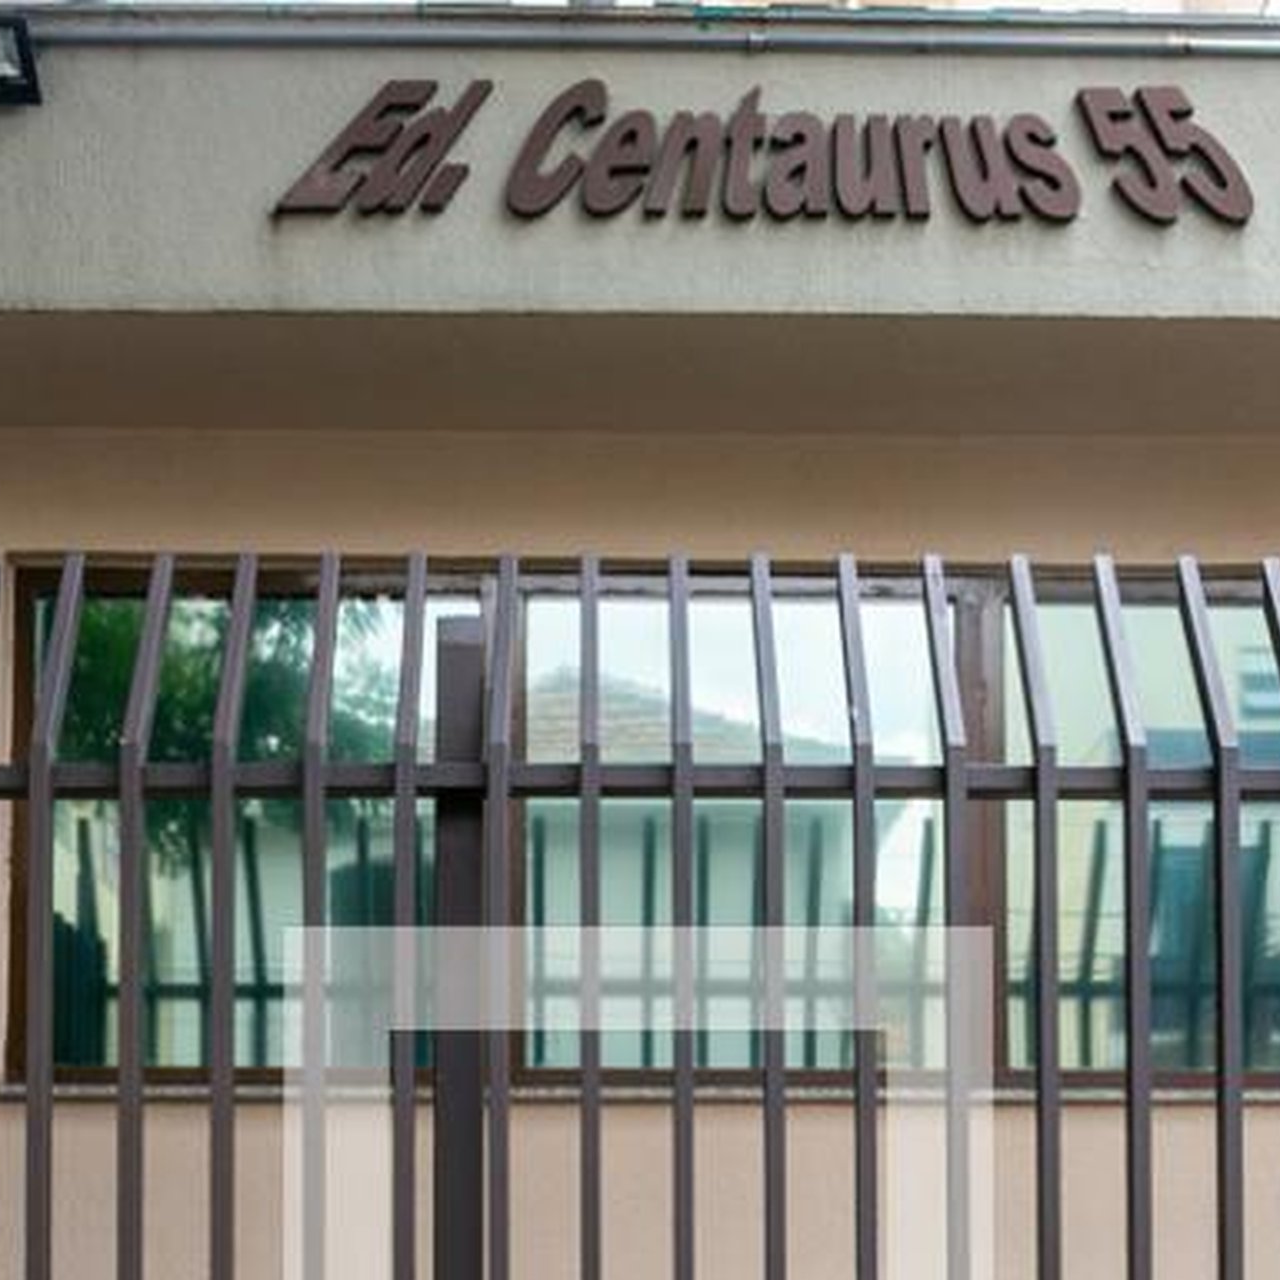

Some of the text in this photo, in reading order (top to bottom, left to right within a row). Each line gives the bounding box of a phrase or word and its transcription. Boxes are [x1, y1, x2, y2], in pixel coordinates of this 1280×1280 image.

[273, 78, 1256, 228] Ed. Centaurus 55
